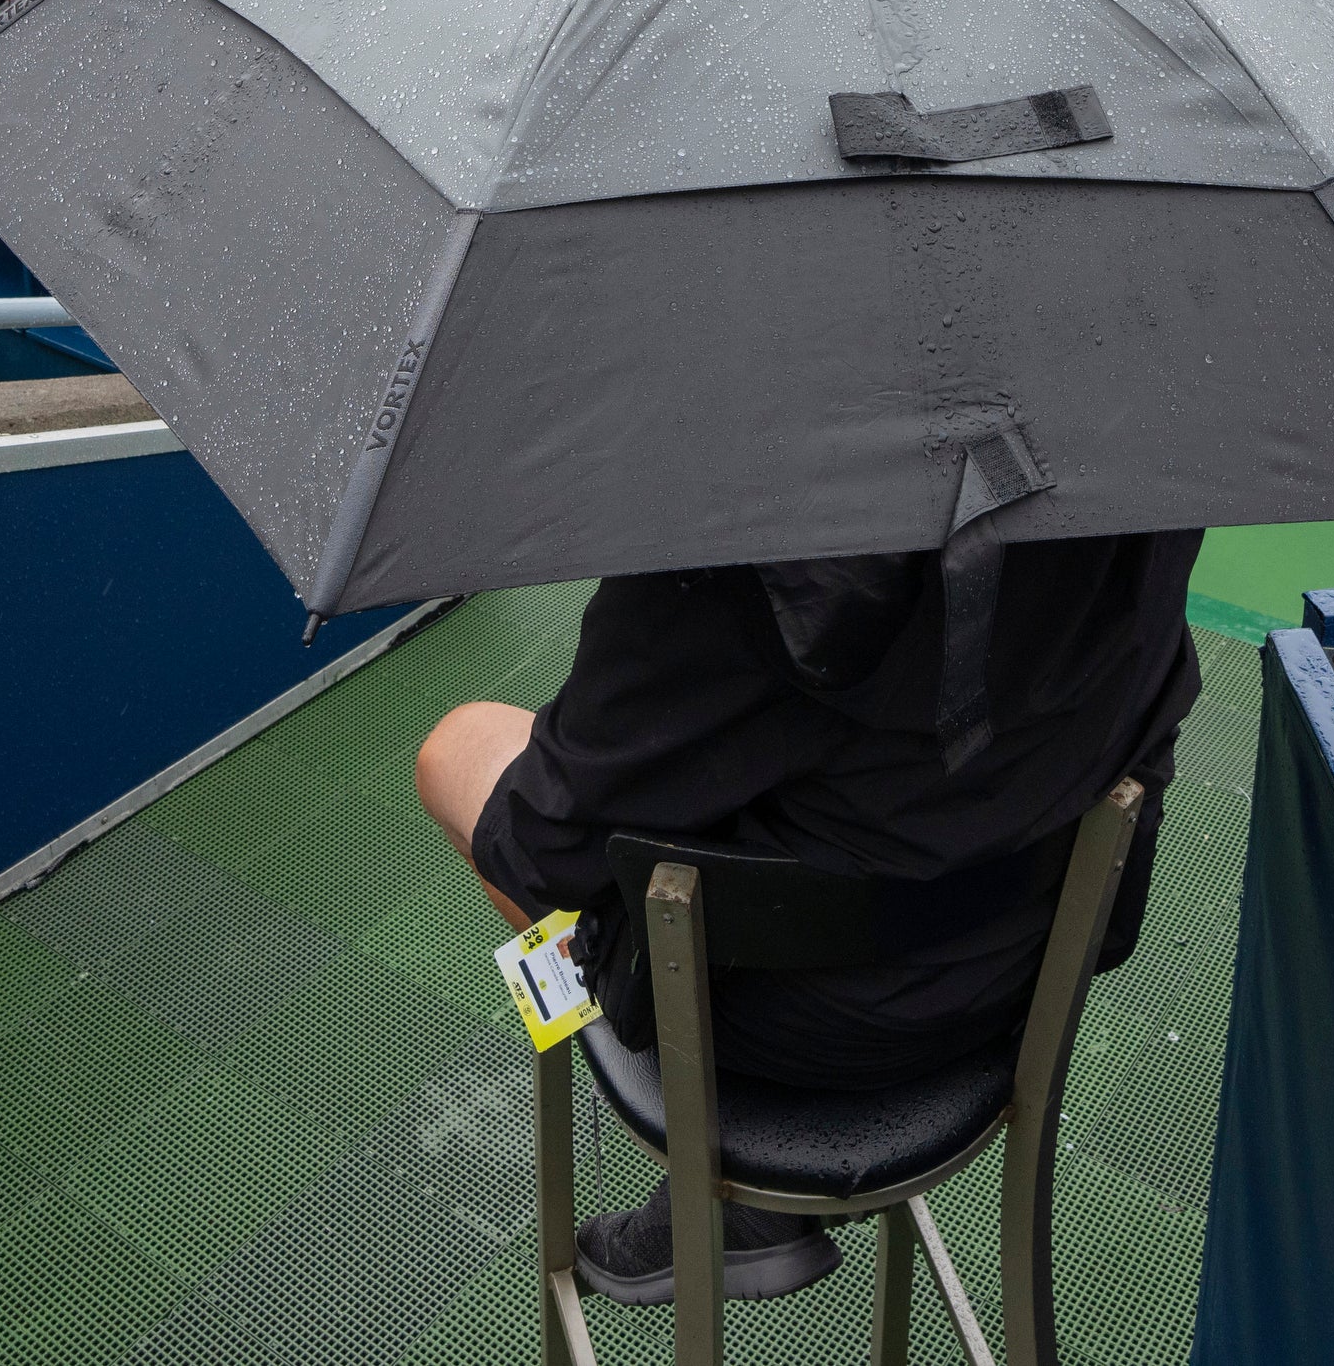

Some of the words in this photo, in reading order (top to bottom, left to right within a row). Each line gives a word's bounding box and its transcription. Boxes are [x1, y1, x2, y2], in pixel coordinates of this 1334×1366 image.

[365, 339, 428, 451] VORTEX
[522, 932, 537, 951] 24
[529, 926, 545, 945] 20
